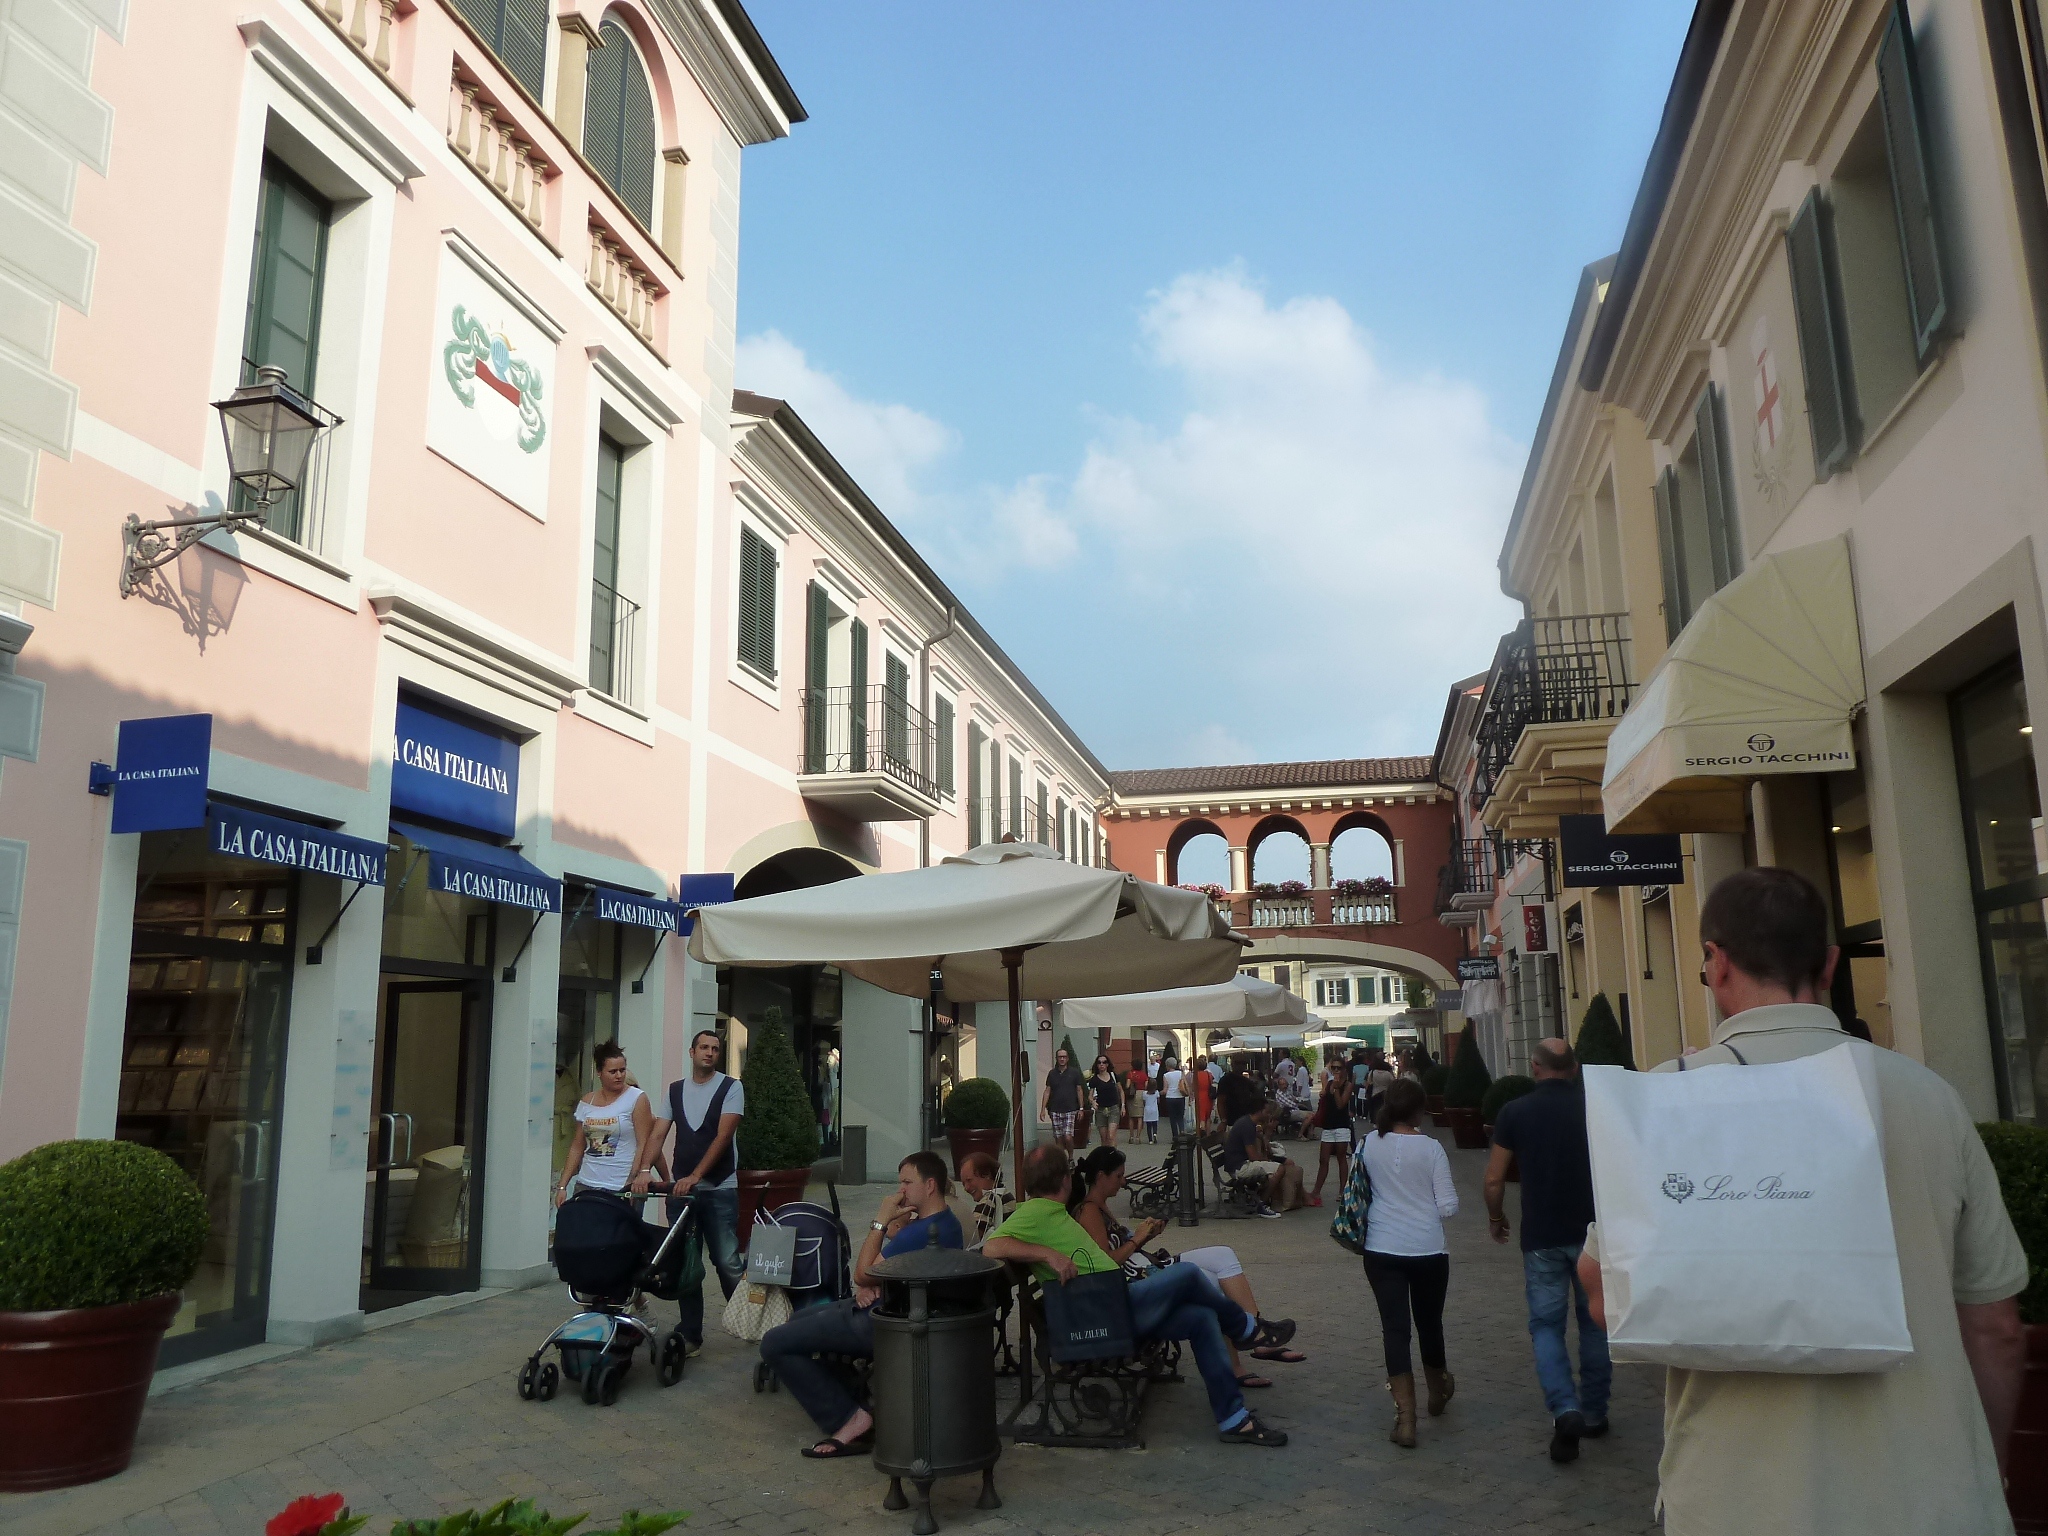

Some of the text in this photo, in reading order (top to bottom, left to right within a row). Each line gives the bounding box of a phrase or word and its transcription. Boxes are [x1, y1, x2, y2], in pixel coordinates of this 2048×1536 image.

[394, 735, 509, 795] A CASA ITALIANA
[1685, 752, 1849, 766] SERGIO TACCHINI
[119, 766, 200, 781] LA CASA ITALIANA
[218, 821, 379, 882] LA CASA ITALIANA
[1568, 862, 1677, 872] SERGIO TACCHINI
[443, 866, 551, 910] LA CASA ITALIANA
[600, 898, 676, 931] LA CASA ITALIANA
[1697, 1172, 1815, 1200] Loro Piana
[764, 1255, 785, 1276] gufo
[1070, 1328, 1108, 1341] PAL ZILERI
